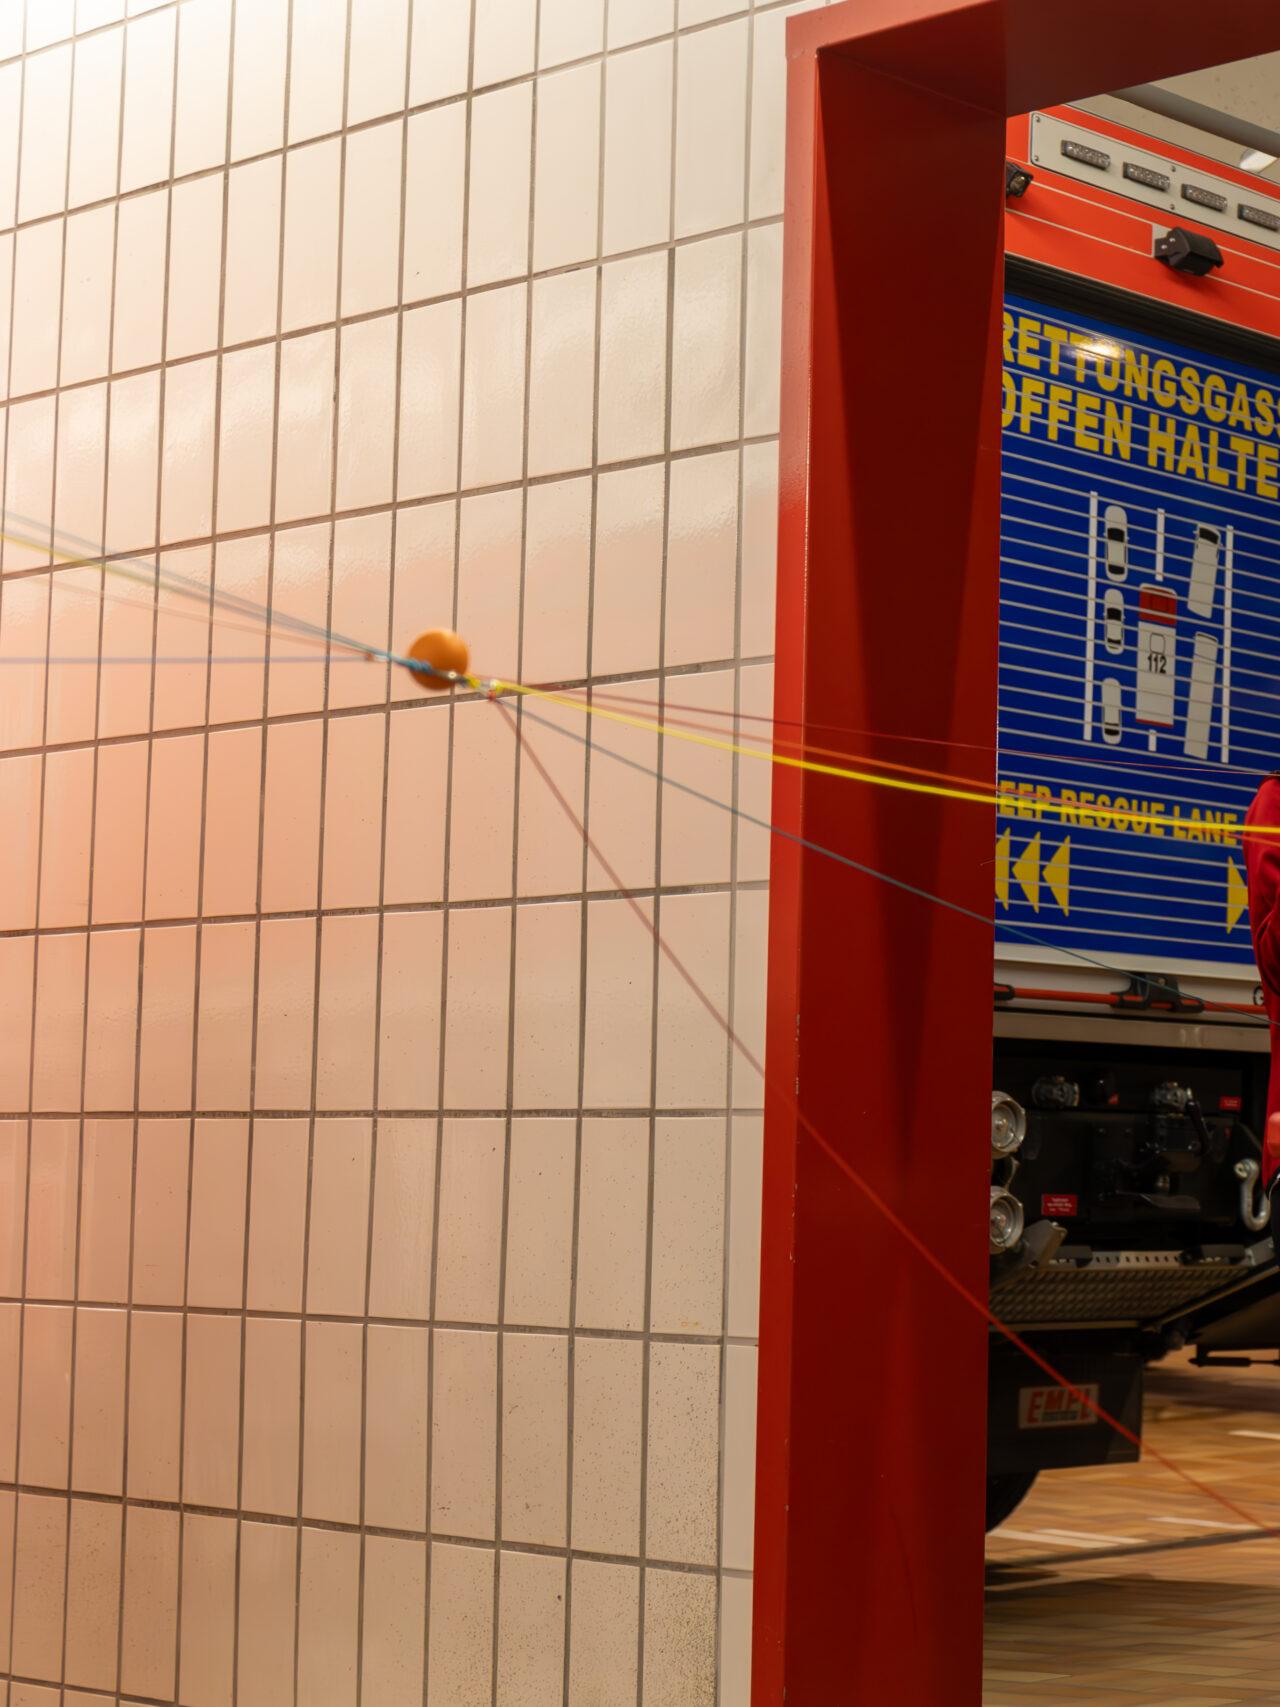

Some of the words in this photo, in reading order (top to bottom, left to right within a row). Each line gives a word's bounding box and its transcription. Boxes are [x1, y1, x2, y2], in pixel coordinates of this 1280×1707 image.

[1001, 370, 1133, 461] OFFEN
[1147, 653, 1167, 675] 112
[1000, 780, 1052, 820] EEP
[1060, 788, 1165, 837] RESCUE
[1173, 805, 1238, 846] LANE
